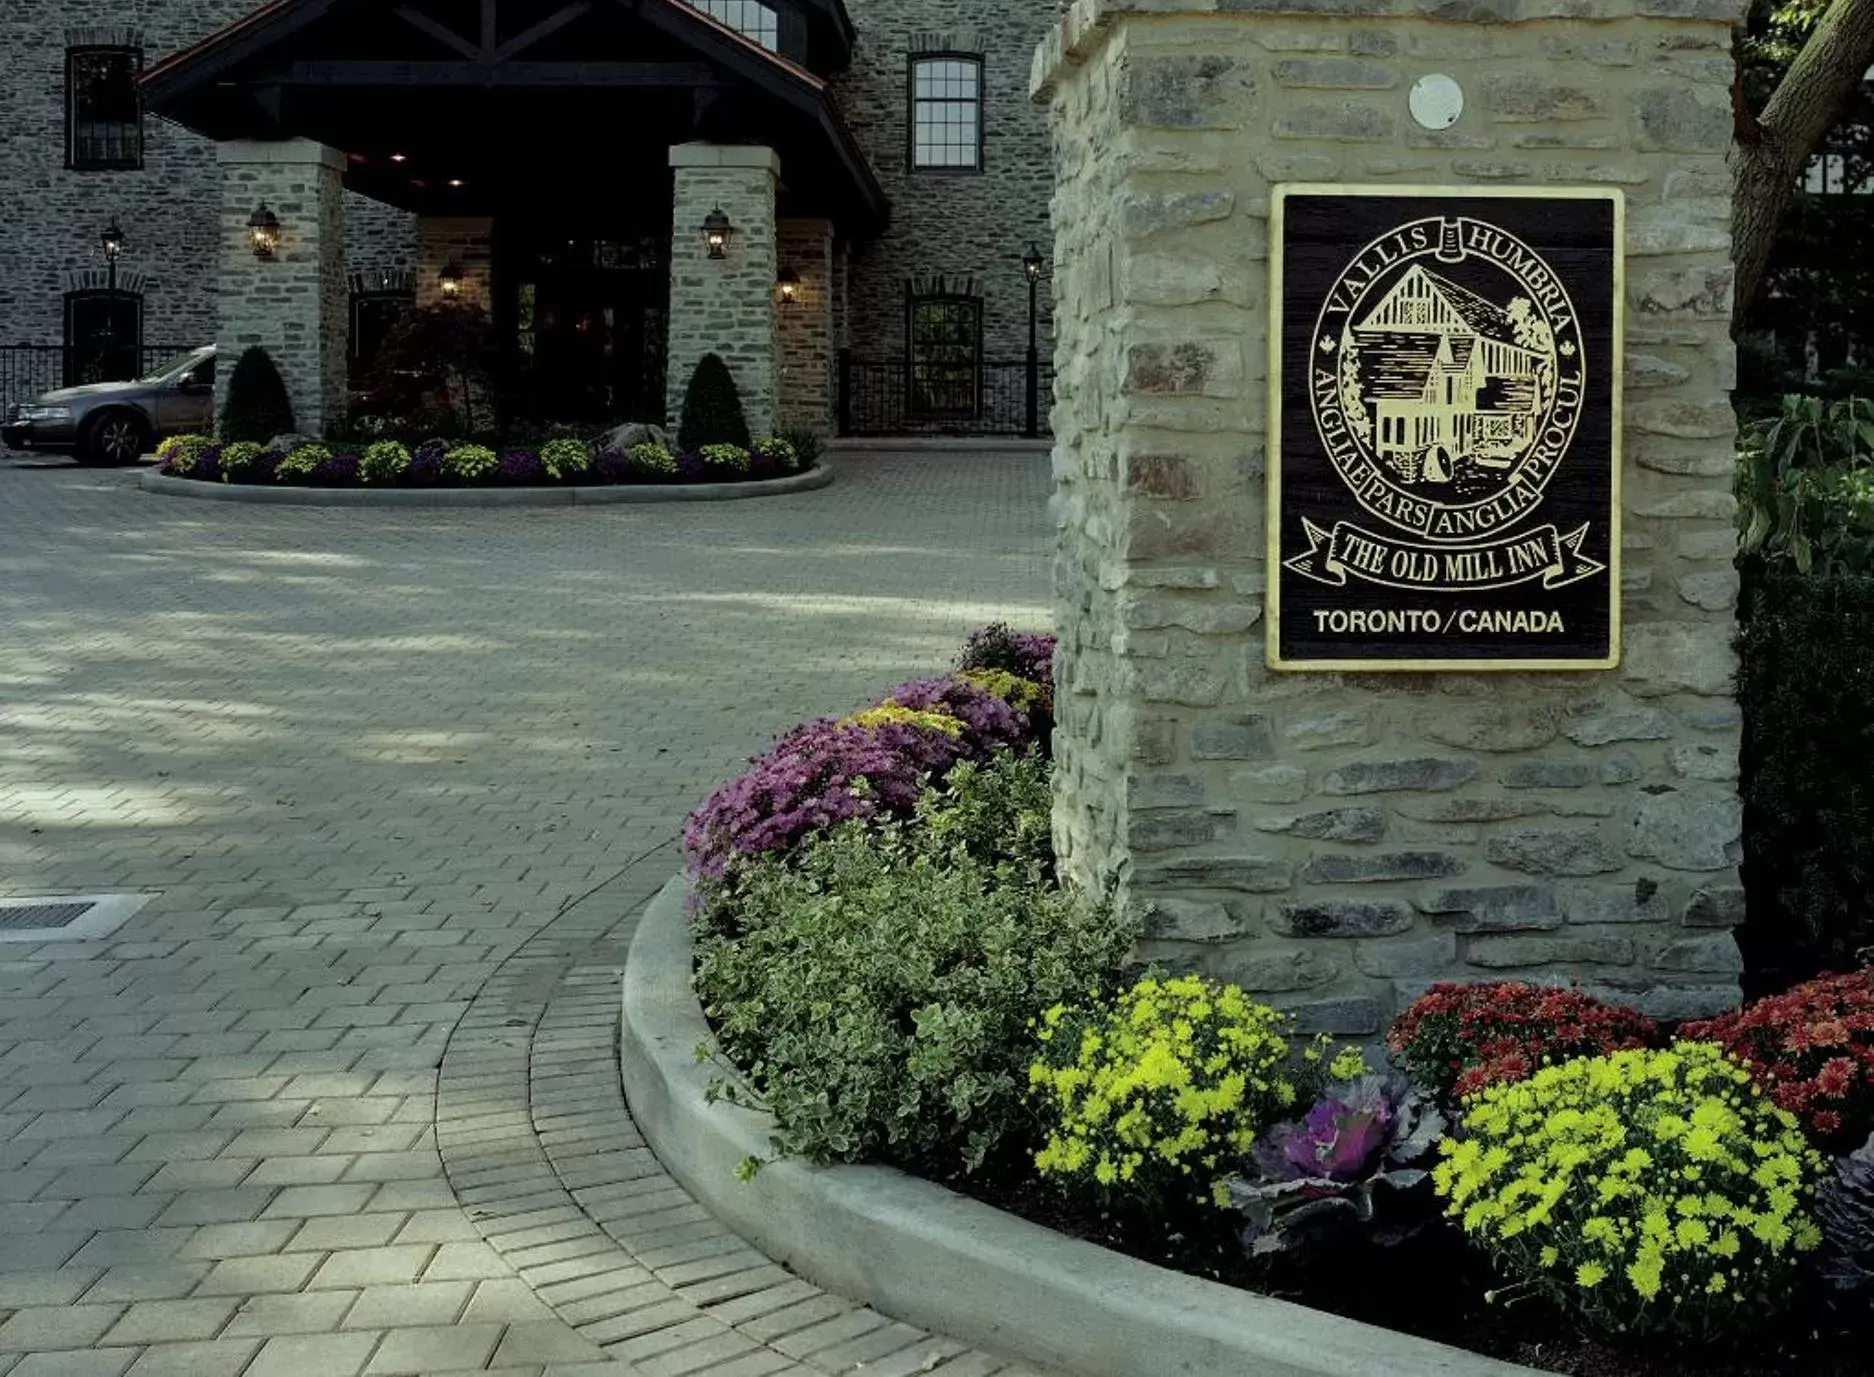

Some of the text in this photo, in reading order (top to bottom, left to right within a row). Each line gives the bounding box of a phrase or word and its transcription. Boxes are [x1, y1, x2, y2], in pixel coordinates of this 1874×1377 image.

[1327, 226, 1428, 315] VALLIS
[1469, 228, 1574, 334] HUMBRIA
[1315, 368, 1371, 489] ANGLIAE
[1530, 370, 1581, 483] PROCUL
[1364, 482, 1429, 527] PARS
[1434, 484, 1536, 535] ANGLIA
[1342, 533, 1549, 582] THE OLD MILL INN
